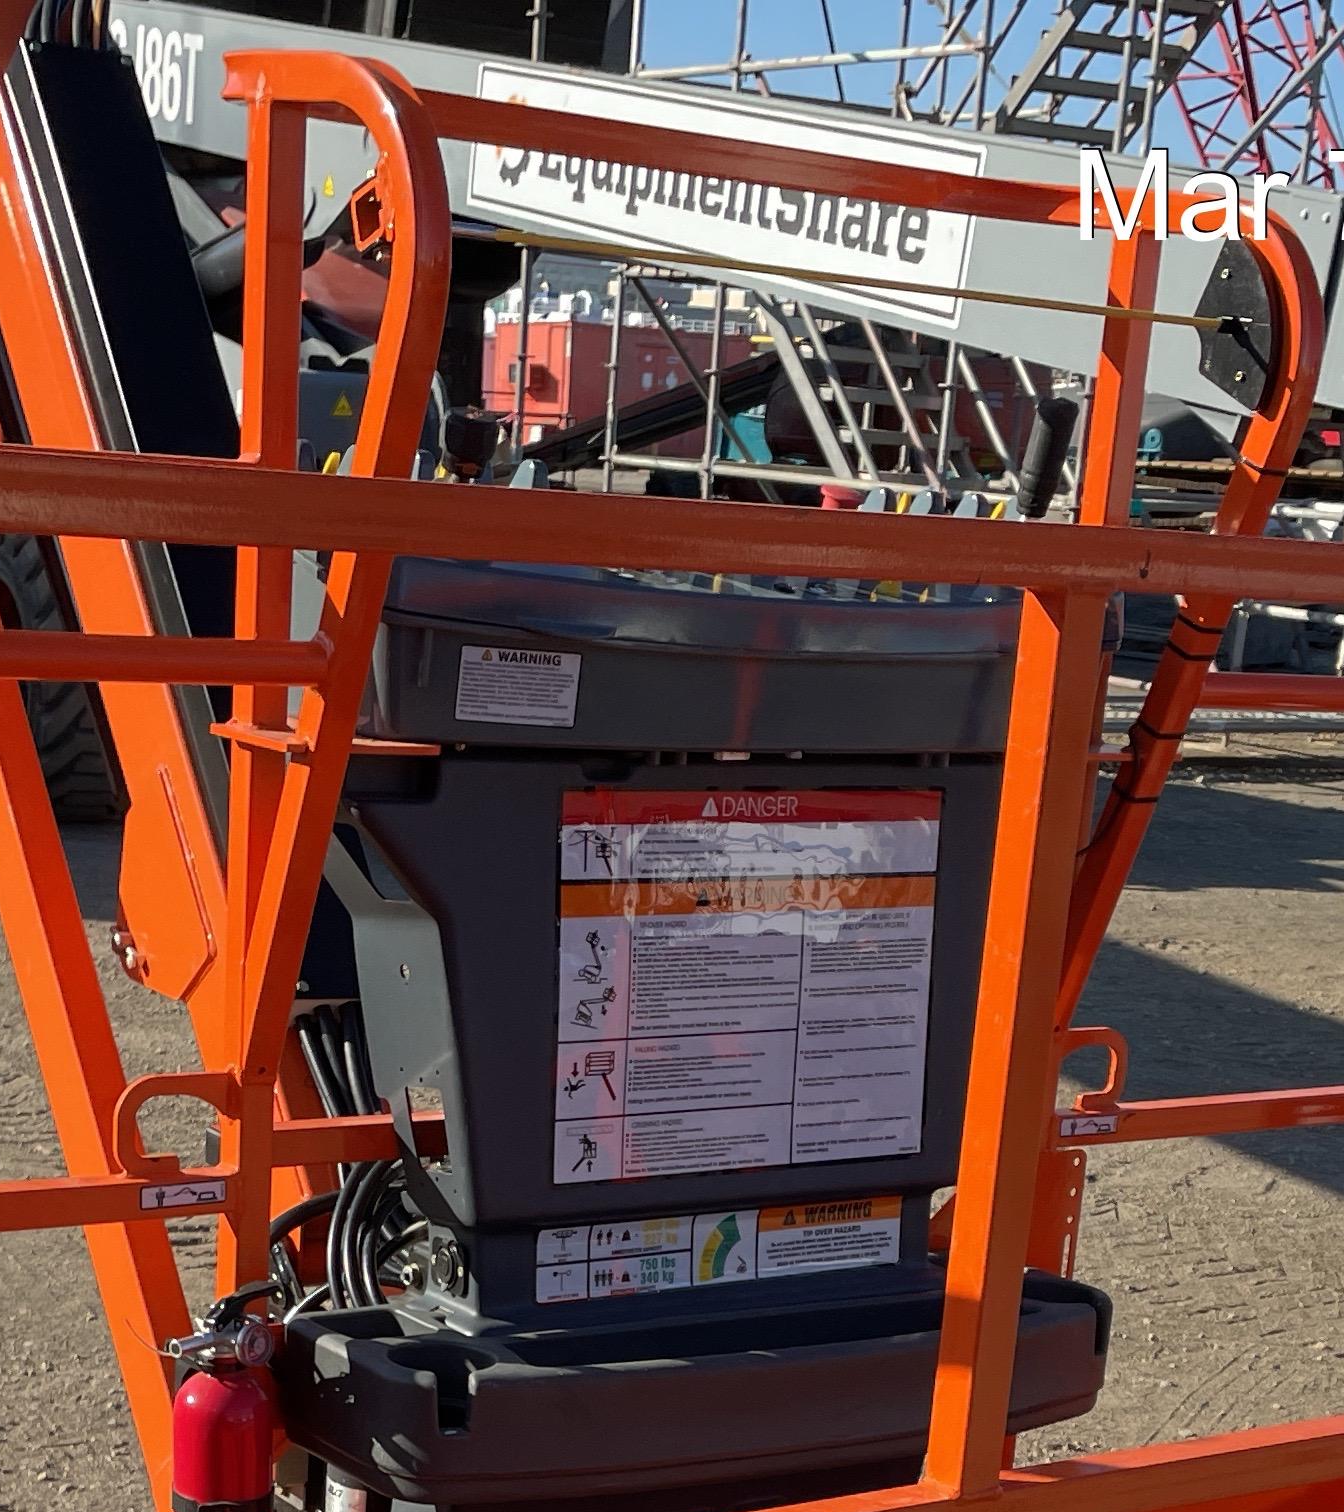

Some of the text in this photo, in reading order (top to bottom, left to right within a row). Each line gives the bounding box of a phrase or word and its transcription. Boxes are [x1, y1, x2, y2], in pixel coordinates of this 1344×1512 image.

[497, 651, 562, 666] WARNING
[722, 795, 799, 818] DANGER
[804, 1200, 873, 1224] WARNING
[640, 1256, 676, 1270] 750 lbs
[640, 1270, 675, 1285] 340 kg
